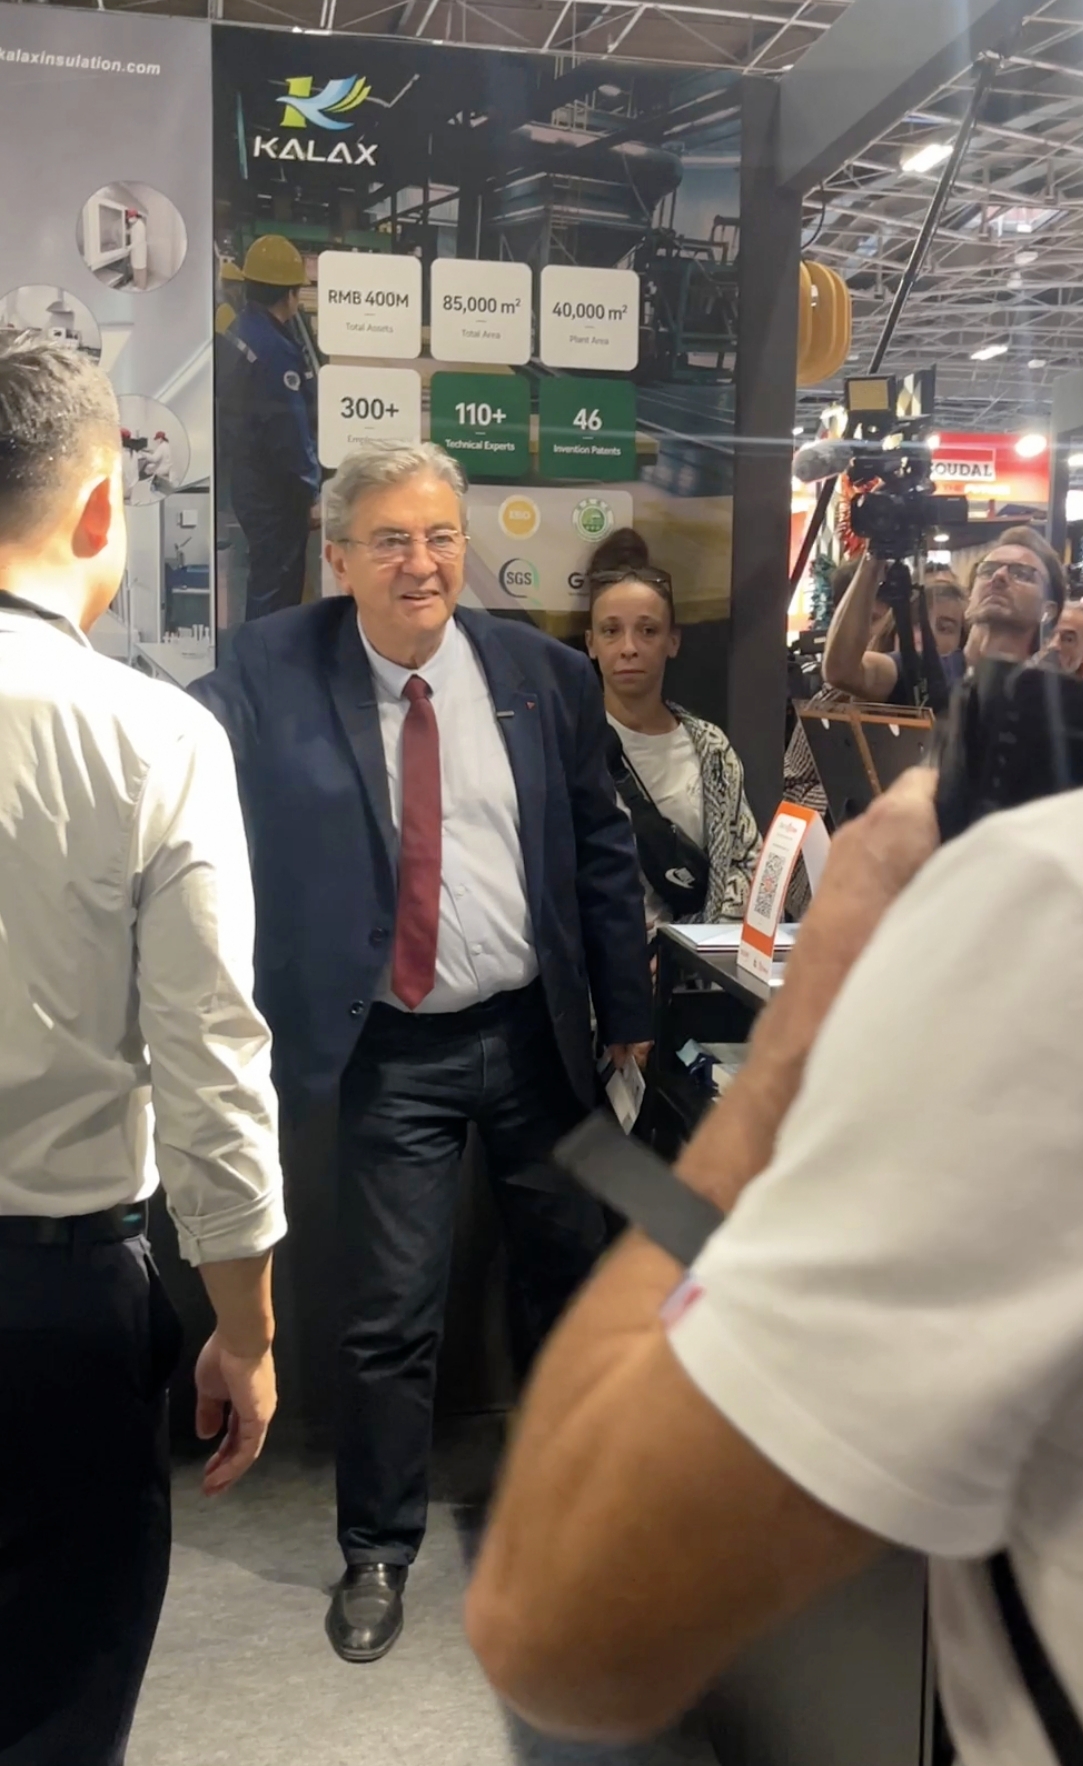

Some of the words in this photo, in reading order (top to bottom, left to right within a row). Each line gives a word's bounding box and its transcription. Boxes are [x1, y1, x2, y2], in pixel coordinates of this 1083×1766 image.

[0, 47, 161, 75] kalaxinsulation.com
[253, 135, 378, 166] KALAX
[328, 289, 362, 305] RMB
[365, 291, 409, 308] 400M
[443, 295, 498, 315] 85,000
[552, 302, 605, 320] 40,000
[346, 322, 365, 332] Total
[366, 323, 394, 333] Assets
[462, 329, 480, 338] Total
[482, 330, 501, 340] Area
[569, 335, 590, 344] Plant
[591, 336, 609, 345] Area
[341, 396, 399, 420] 300+
[455, 402, 507, 426] 110+
[573, 408, 603, 431] 46
[445, 439, 483, 450] Technical
[484, 441, 516, 452] Experts
[553, 444, 590, 454] Invention
[591, 445, 622, 456] Patents
[506, 571, 532, 585] SGS
